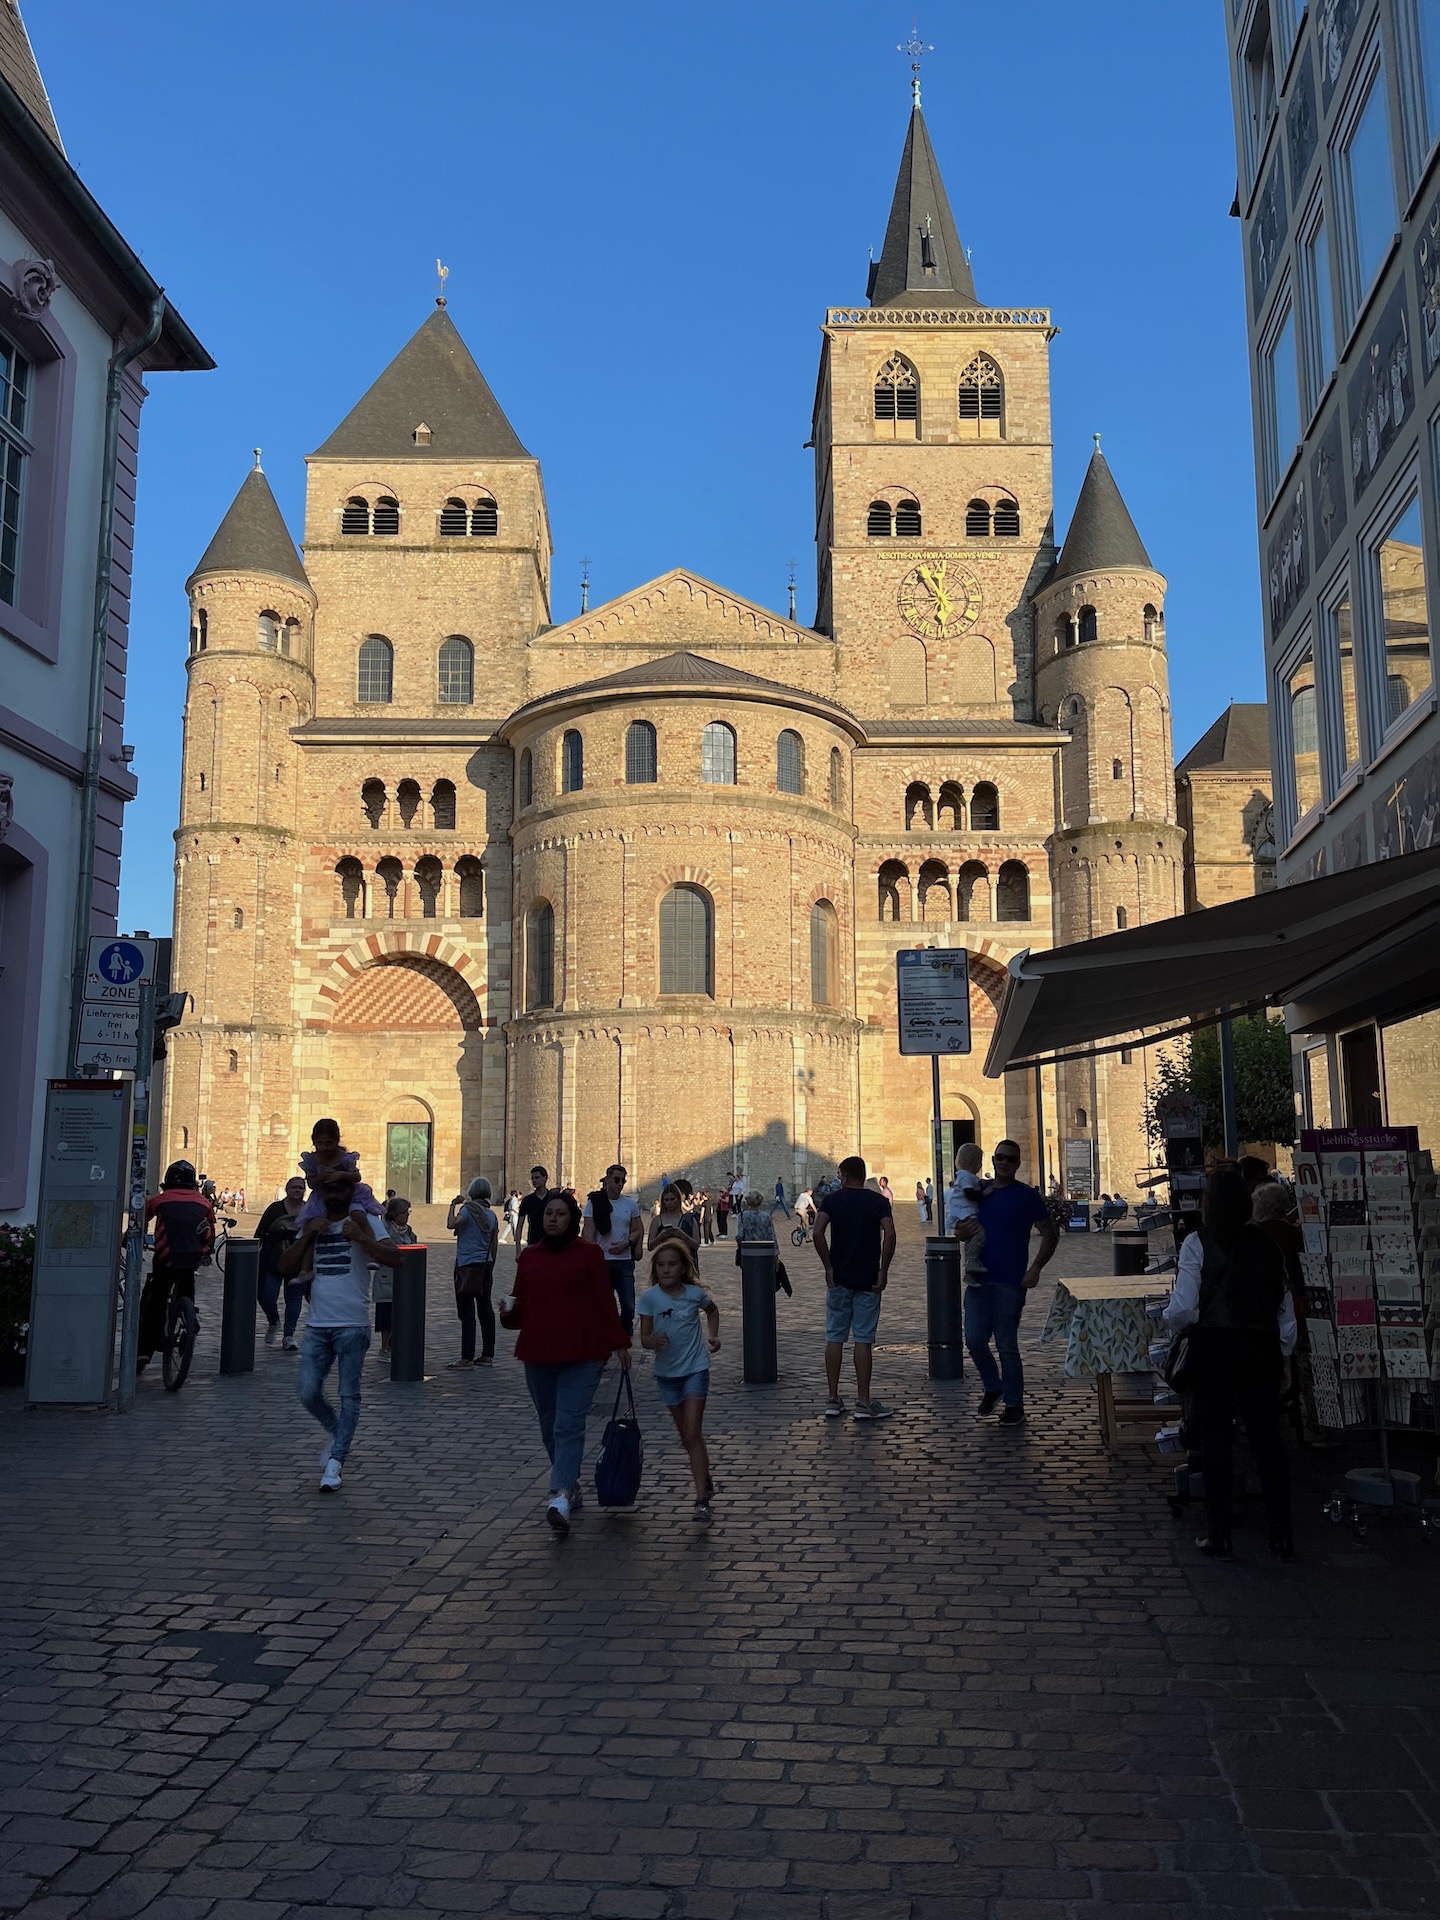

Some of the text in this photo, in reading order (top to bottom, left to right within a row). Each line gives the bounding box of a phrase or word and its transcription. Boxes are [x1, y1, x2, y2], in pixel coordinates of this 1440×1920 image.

[101, 987, 136, 999] ZONE
[87, 1009, 139, 1020] Lieferverkeh
[108, 1021, 122, 1029] frei
[98, 1030, 103, 1038] 6
[112, 1031, 120, 1039] 11
[116, 1054, 130, 1063] frei
[1322, 1133, 1397, 1147] Lieblingsstücke
